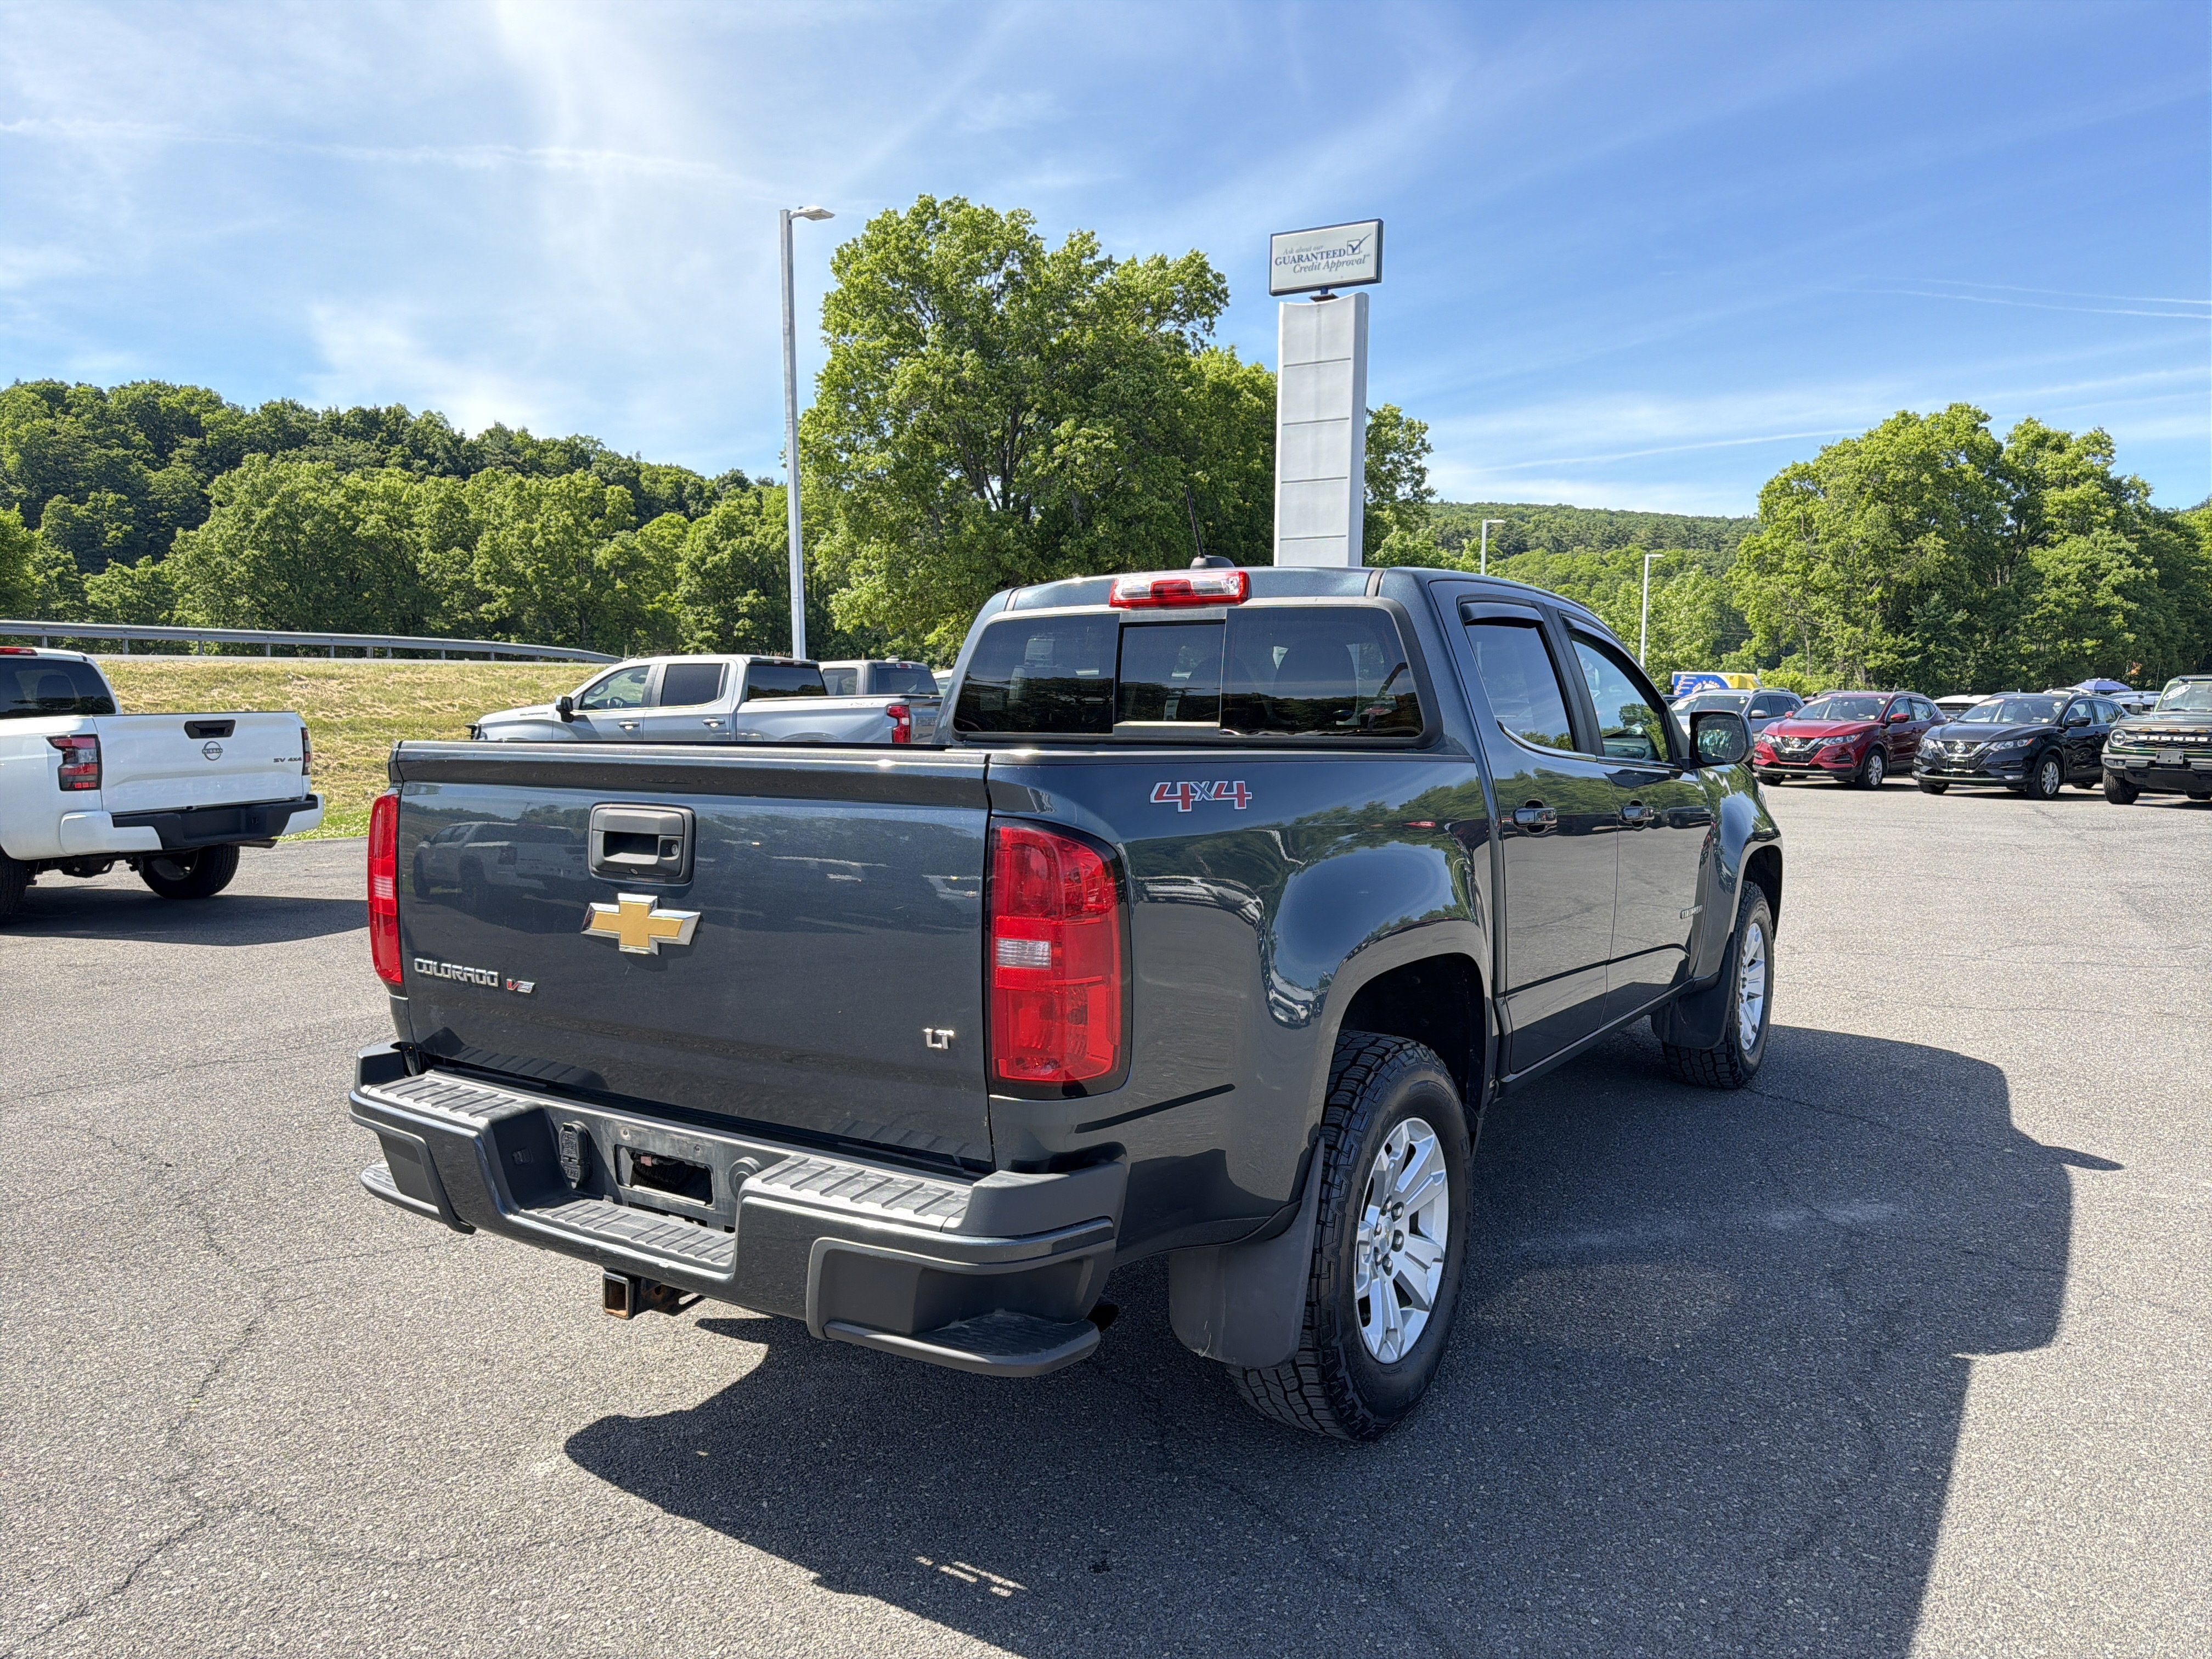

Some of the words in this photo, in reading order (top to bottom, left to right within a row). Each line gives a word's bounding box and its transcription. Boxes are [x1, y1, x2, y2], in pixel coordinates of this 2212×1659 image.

[1274, 248, 1346, 266] GUARANTEED
[1293, 262, 1321, 274] Credit
[414, 958, 500, 988] COLORADO
[922, 1028, 955, 1049] LT
